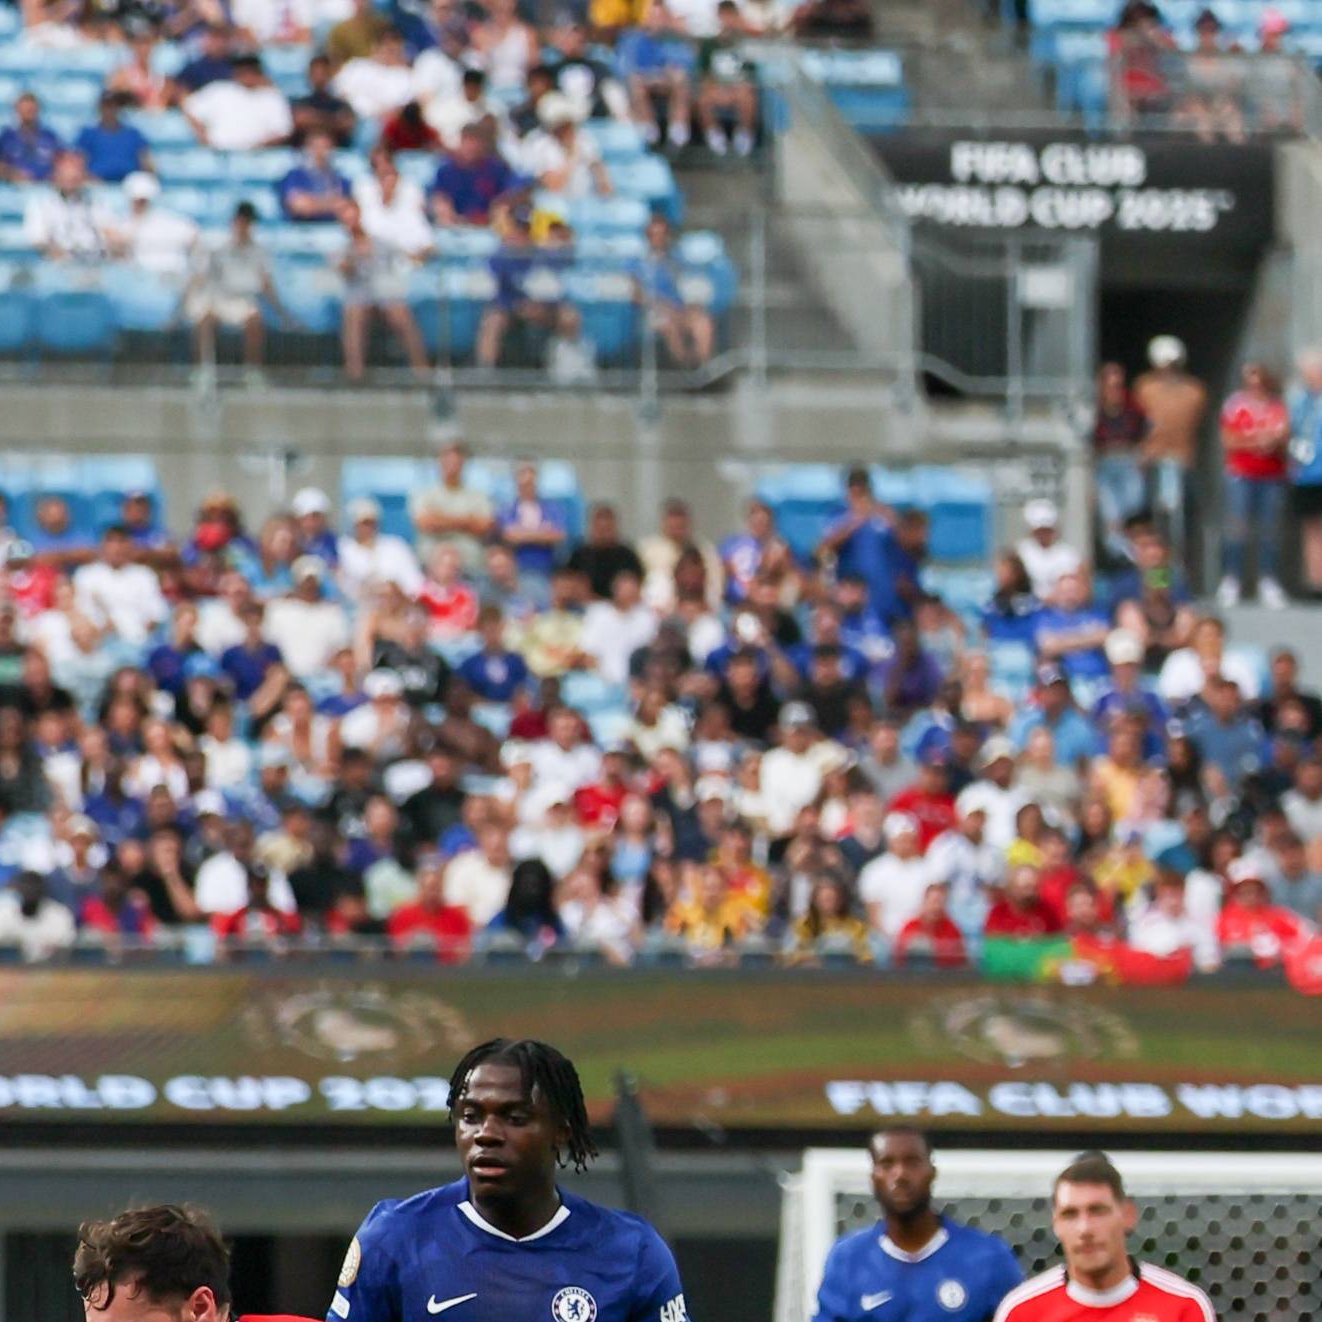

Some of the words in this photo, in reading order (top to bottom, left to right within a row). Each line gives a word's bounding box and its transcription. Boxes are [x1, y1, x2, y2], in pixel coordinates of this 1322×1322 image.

[950, 142, 1040, 183] FIFA
[1041, 143, 1147, 187] CLUB
[1031, 187, 1114, 228] CUP
[164, 1075, 311, 1111] CUP
[319, 1077, 451, 1112] 202
[826, 1081, 982, 1117] FIFA
[988, 1082, 1173, 1118] CLUB
